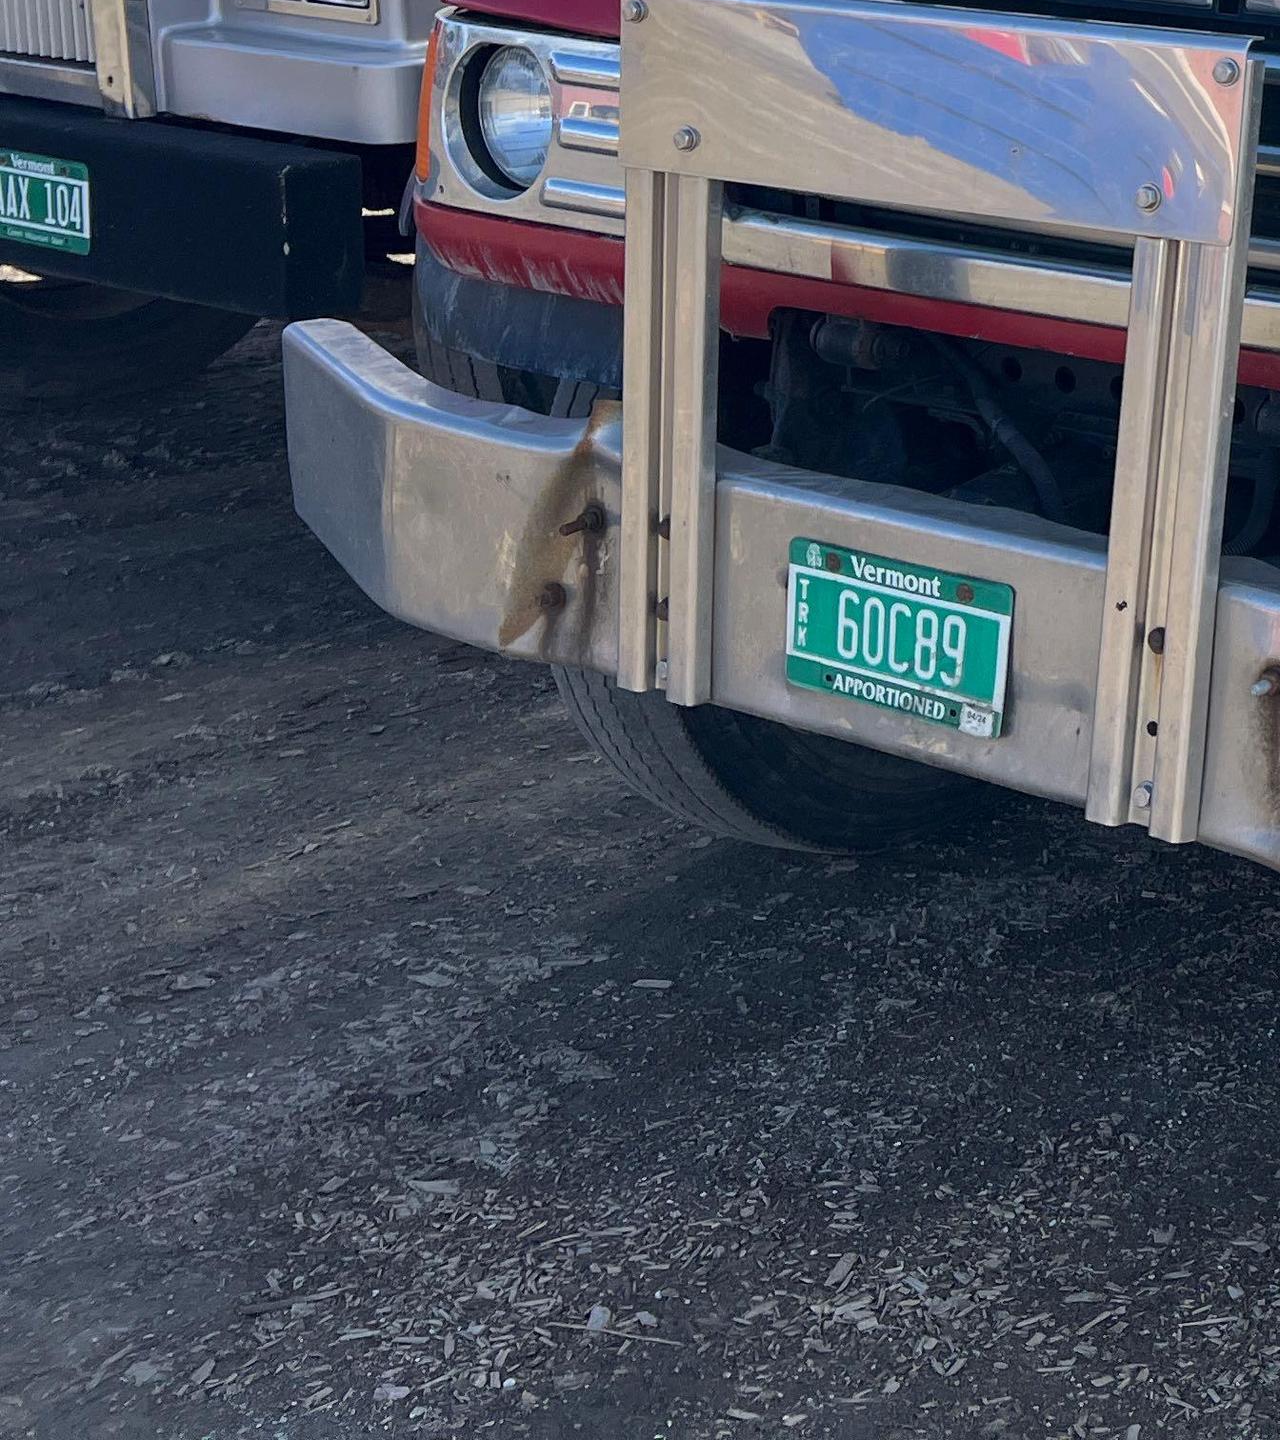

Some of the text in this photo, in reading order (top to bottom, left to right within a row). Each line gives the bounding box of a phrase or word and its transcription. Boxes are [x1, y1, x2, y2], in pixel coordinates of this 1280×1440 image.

[10, 152, 55, 176] Vermont
[43, 181, 82, 230] 104
[850, 555, 942, 598] Vermont
[836, 588, 967, 688] 60C89
[832, 672, 947, 721] APPORTIONED
